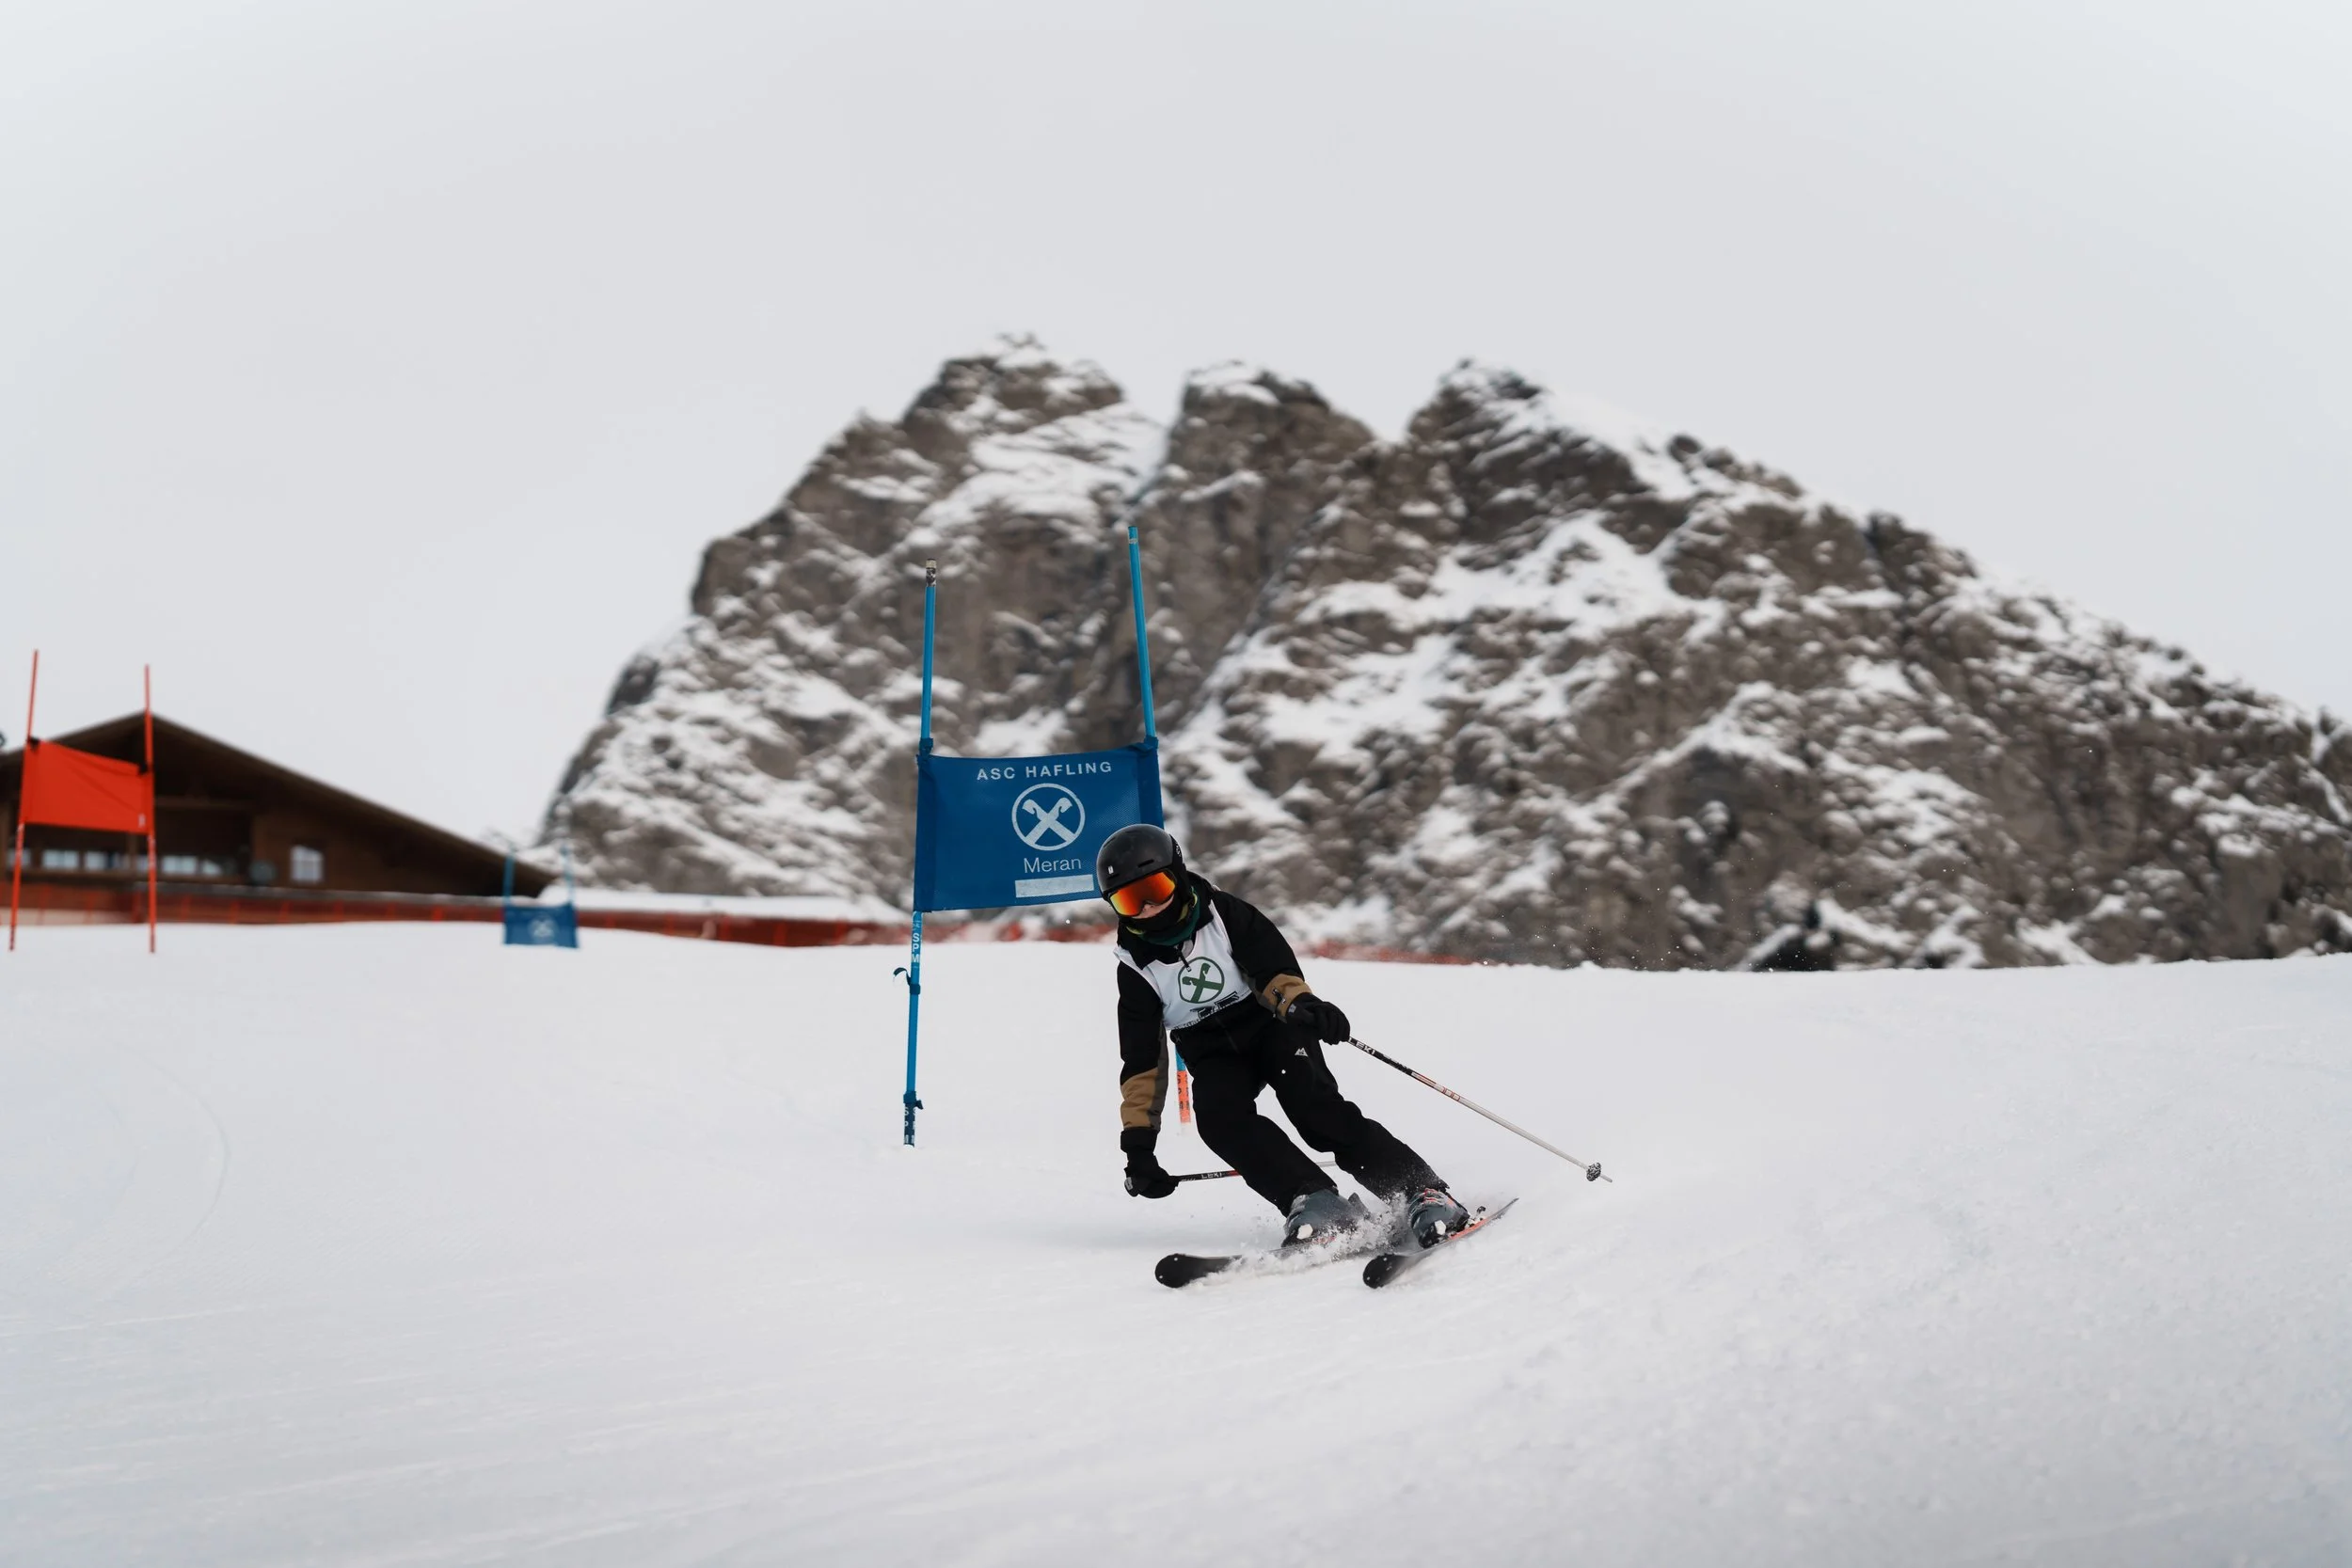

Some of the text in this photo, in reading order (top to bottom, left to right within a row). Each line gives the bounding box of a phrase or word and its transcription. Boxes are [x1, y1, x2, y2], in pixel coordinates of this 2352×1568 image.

[977, 761, 1112, 781] ASC HAFLING
[1024, 857, 1082, 874] Meran
[1200, 1171, 1222, 1180] LEKI
